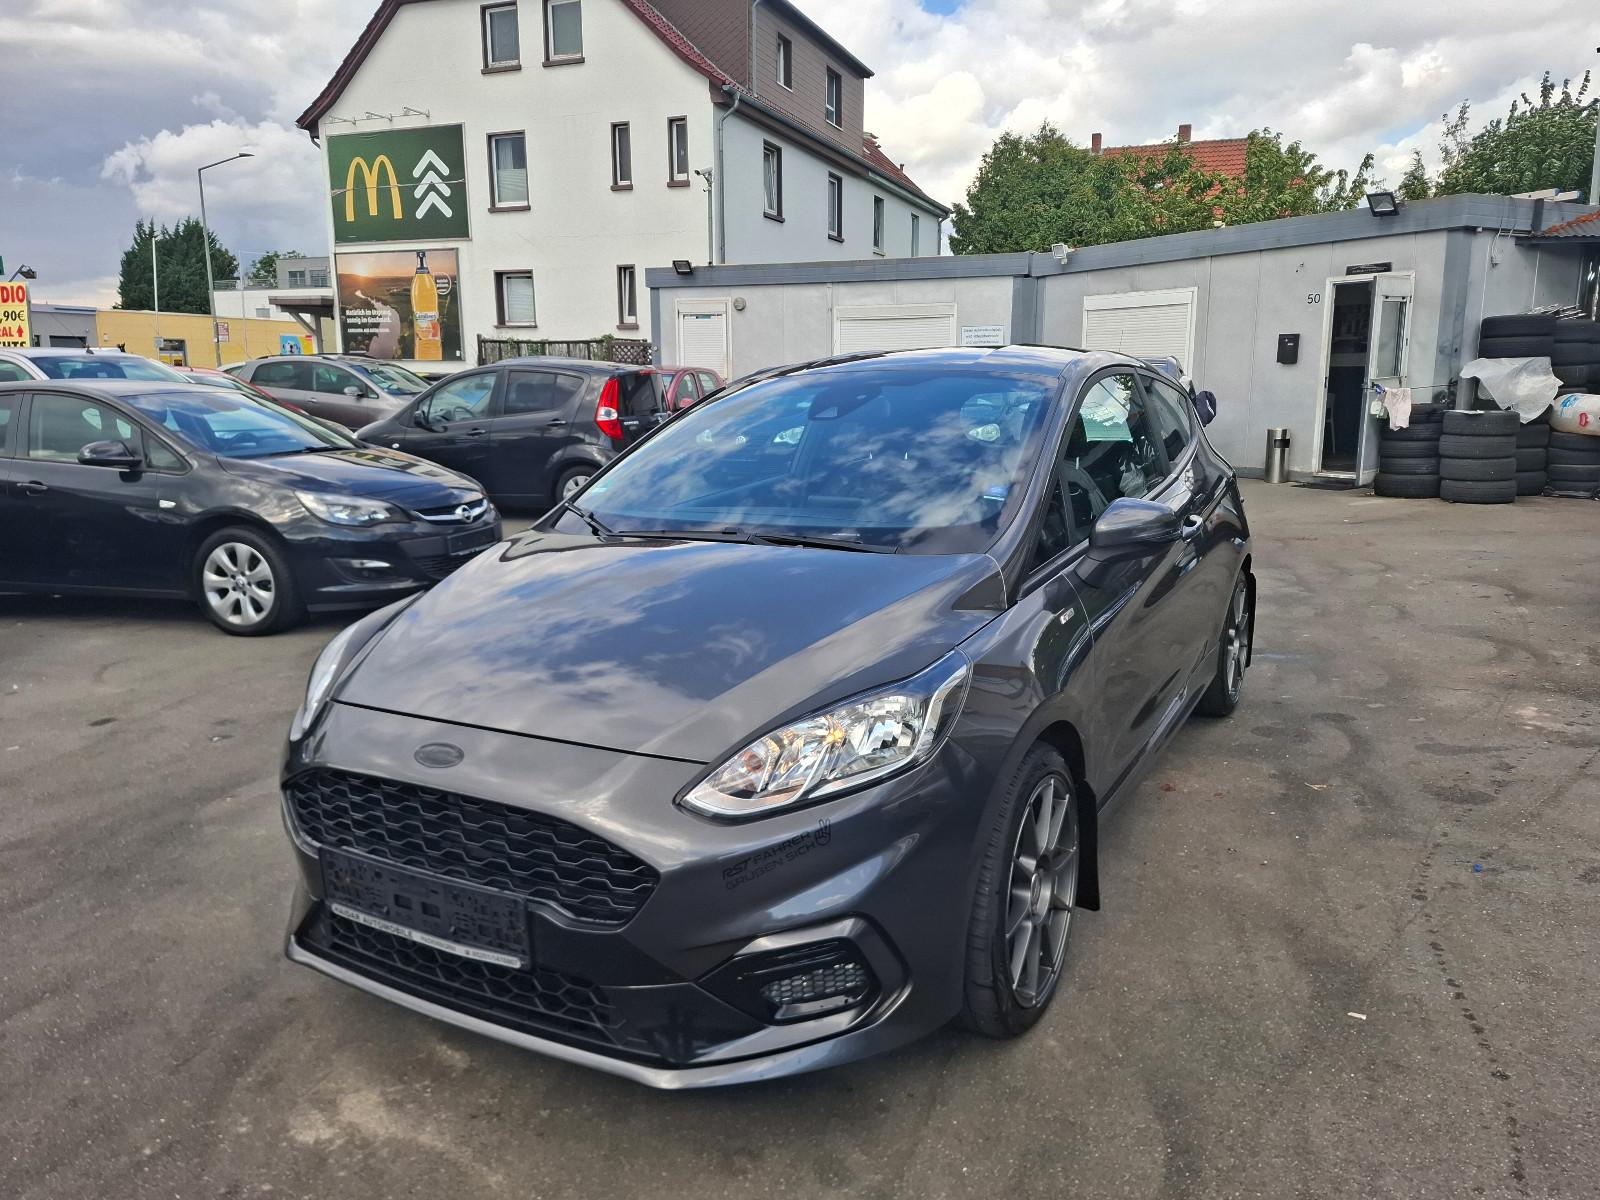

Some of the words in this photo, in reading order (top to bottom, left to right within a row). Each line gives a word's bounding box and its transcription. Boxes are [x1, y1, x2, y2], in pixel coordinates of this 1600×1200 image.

[1307, 293, 1321, 304] 50
[0, 326, 14, 337] AL
[753, 831, 810, 864] FAHRER
[785, 841, 815, 862] SICH
[363, 916, 412, 939] AUTOMOBILE
